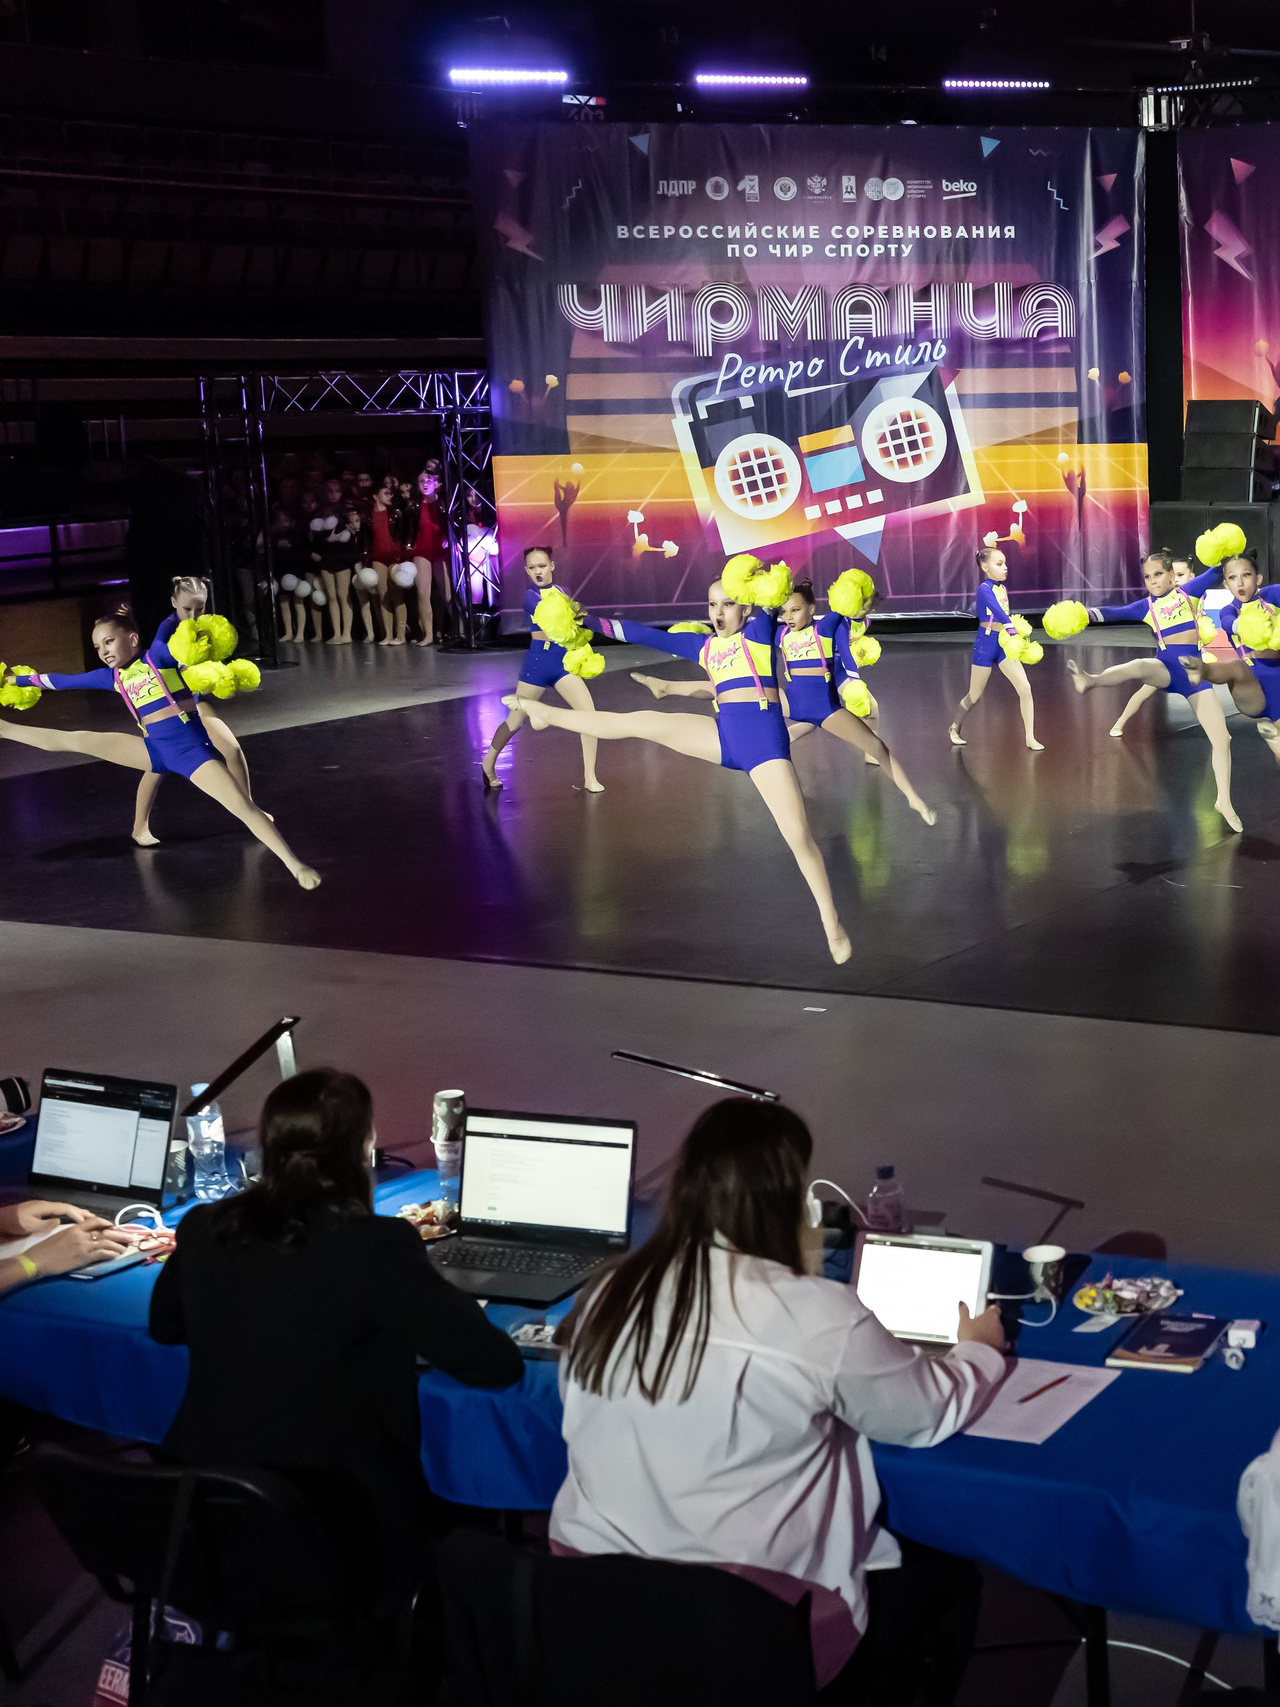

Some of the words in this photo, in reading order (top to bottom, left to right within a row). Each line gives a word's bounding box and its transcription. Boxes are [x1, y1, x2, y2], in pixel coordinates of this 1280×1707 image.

[656, 180, 697, 197] ЛДПР
[942, 179, 977, 192] beko
[617, 222, 820, 240] ВСЕРОССИЙСКИЕ
[831, 225, 1017, 239] СОРЕВНОВАНИЯ
[727, 244, 757, 258] ПО
[768, 244, 814, 258] ЧИР
[824, 244, 914, 258] СПОРТУ
[715, 353, 825, 395] Ретро
[840, 335, 948, 376] Стиль
